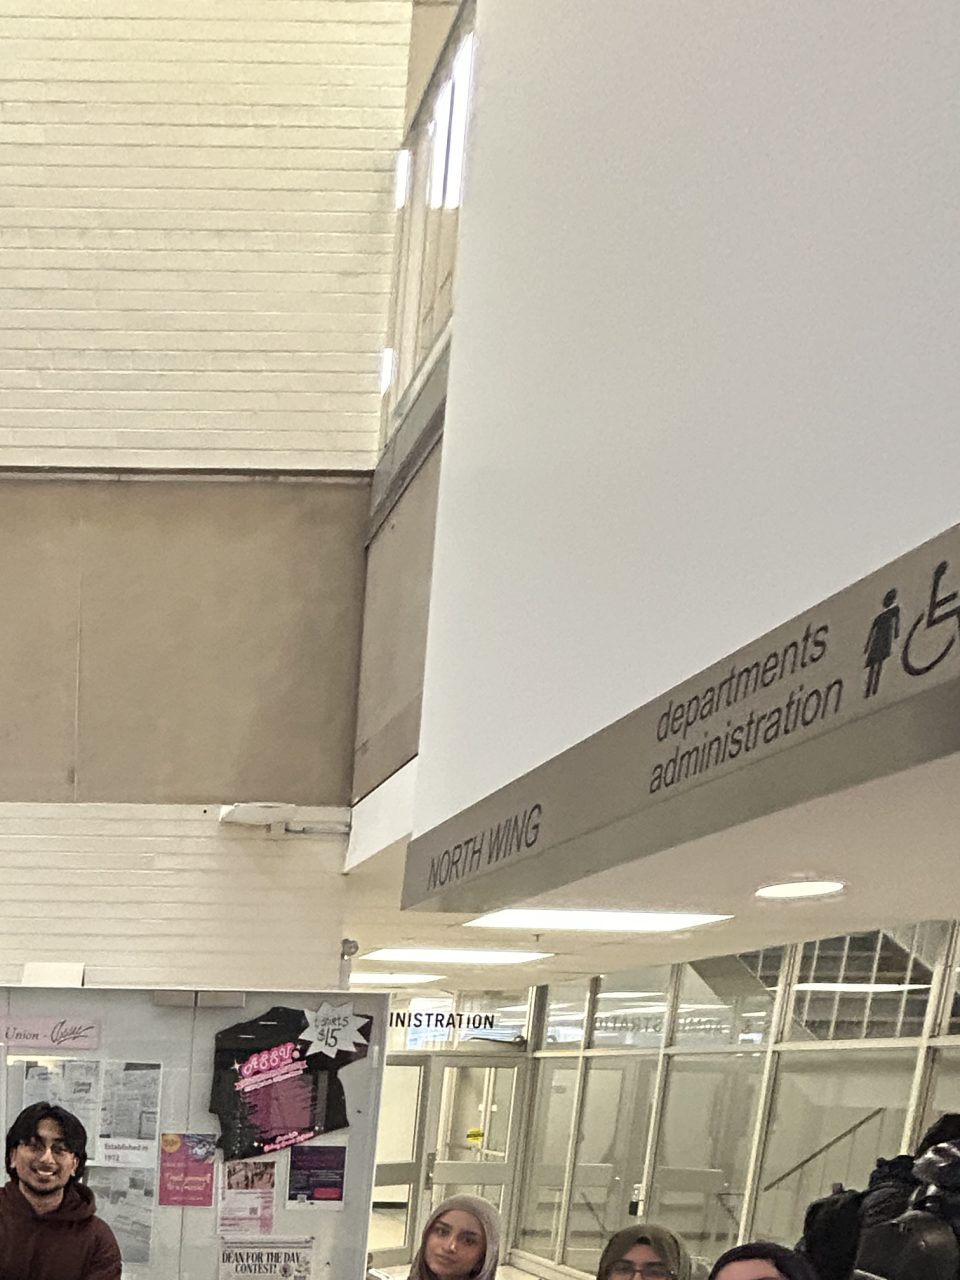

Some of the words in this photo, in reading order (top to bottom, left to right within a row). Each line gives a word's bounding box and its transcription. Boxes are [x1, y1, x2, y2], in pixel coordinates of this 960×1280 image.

[656, 623, 829, 742] departments
[649, 679, 844, 793] administration
[426, 832, 485, 891] NORTH
[487, 803, 542, 865] WING
[5, 1026, 39, 1040] Union
[317, 1027, 341, 1047] $15
[104, 1142, 140, 1150] Established
[222, 1251, 246, 1263] DEAN
[246, 1251, 263, 1263] FOR
[266, 1251, 282, 1263] THE
[284, 1251, 302, 1264] DAY
[235, 1263, 277, 1275] CONTEST!
